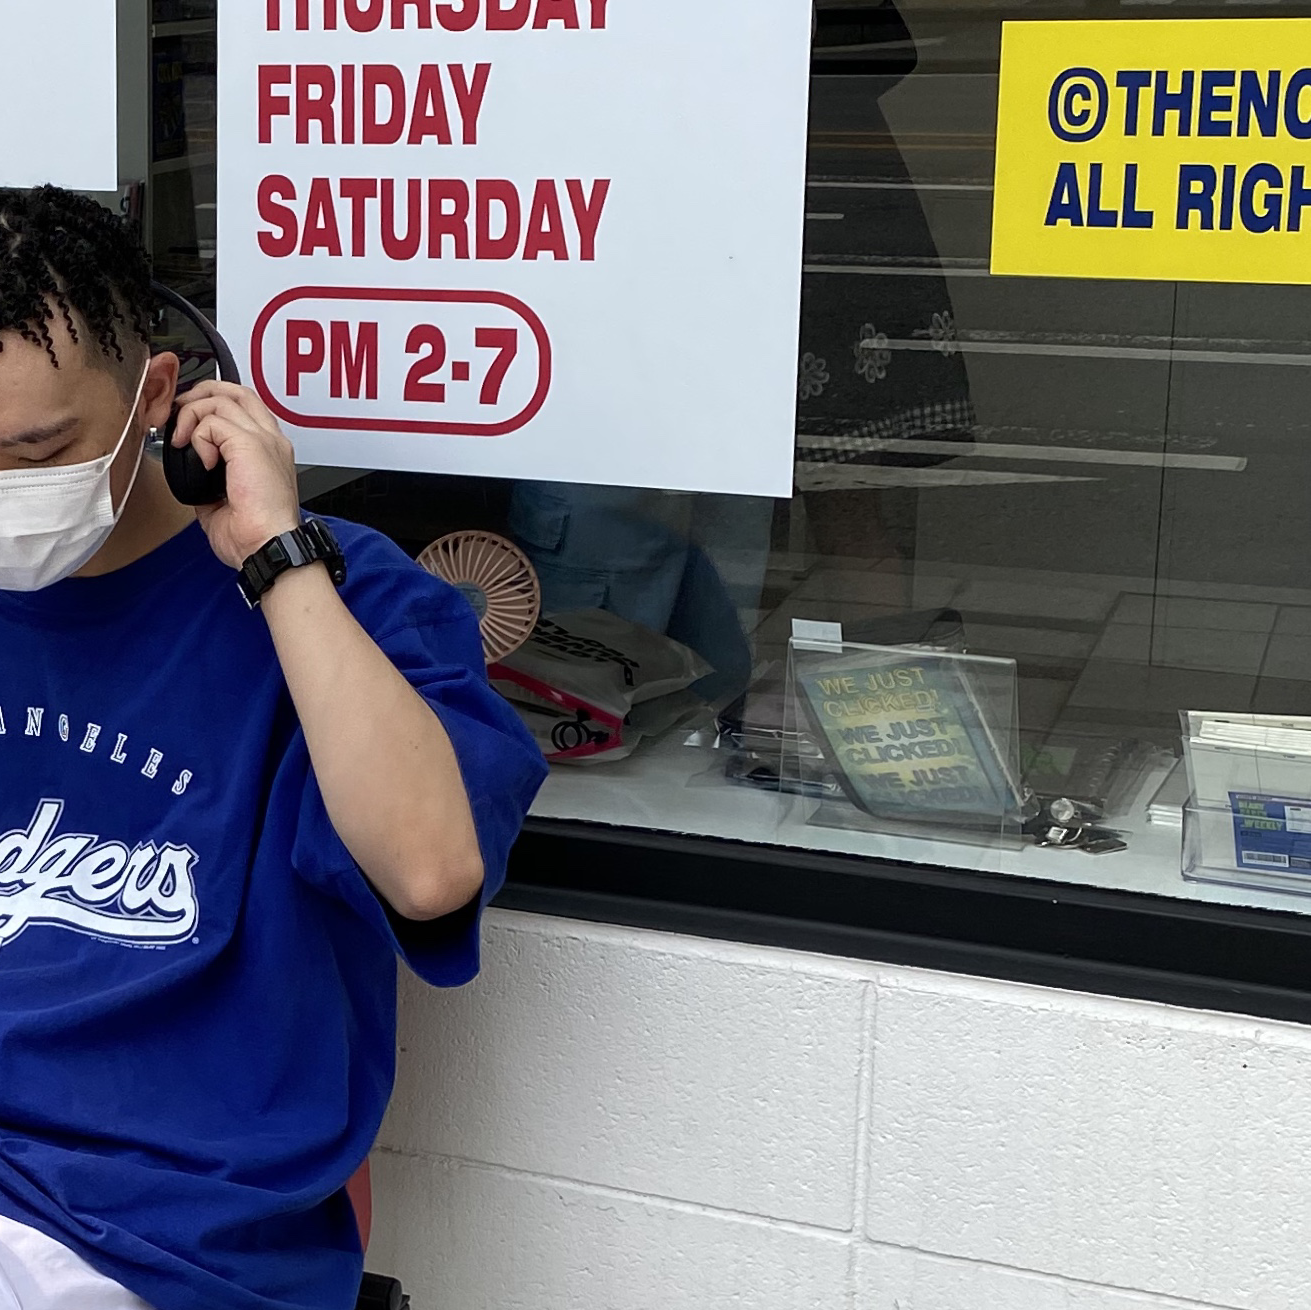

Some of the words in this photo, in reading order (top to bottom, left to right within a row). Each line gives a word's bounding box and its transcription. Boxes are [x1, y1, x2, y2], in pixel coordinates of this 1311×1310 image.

[258, 62, 492, 145] FRIDAY
[257, 174, 611, 261] SATURDAY
[1044, 162, 1154, 229] ALL
[285, 319, 378, 400] PM
[403, 324, 518, 405] 2-7
[817, 677, 859, 695] WE
[866, 667, 926, 691] JUST
[823, 689, 939, 718] CLICKED!
[839, 724, 883, 745] WE
[886, 716, 949, 741] JUST
[845, 738, 963, 766] CLICKED!
